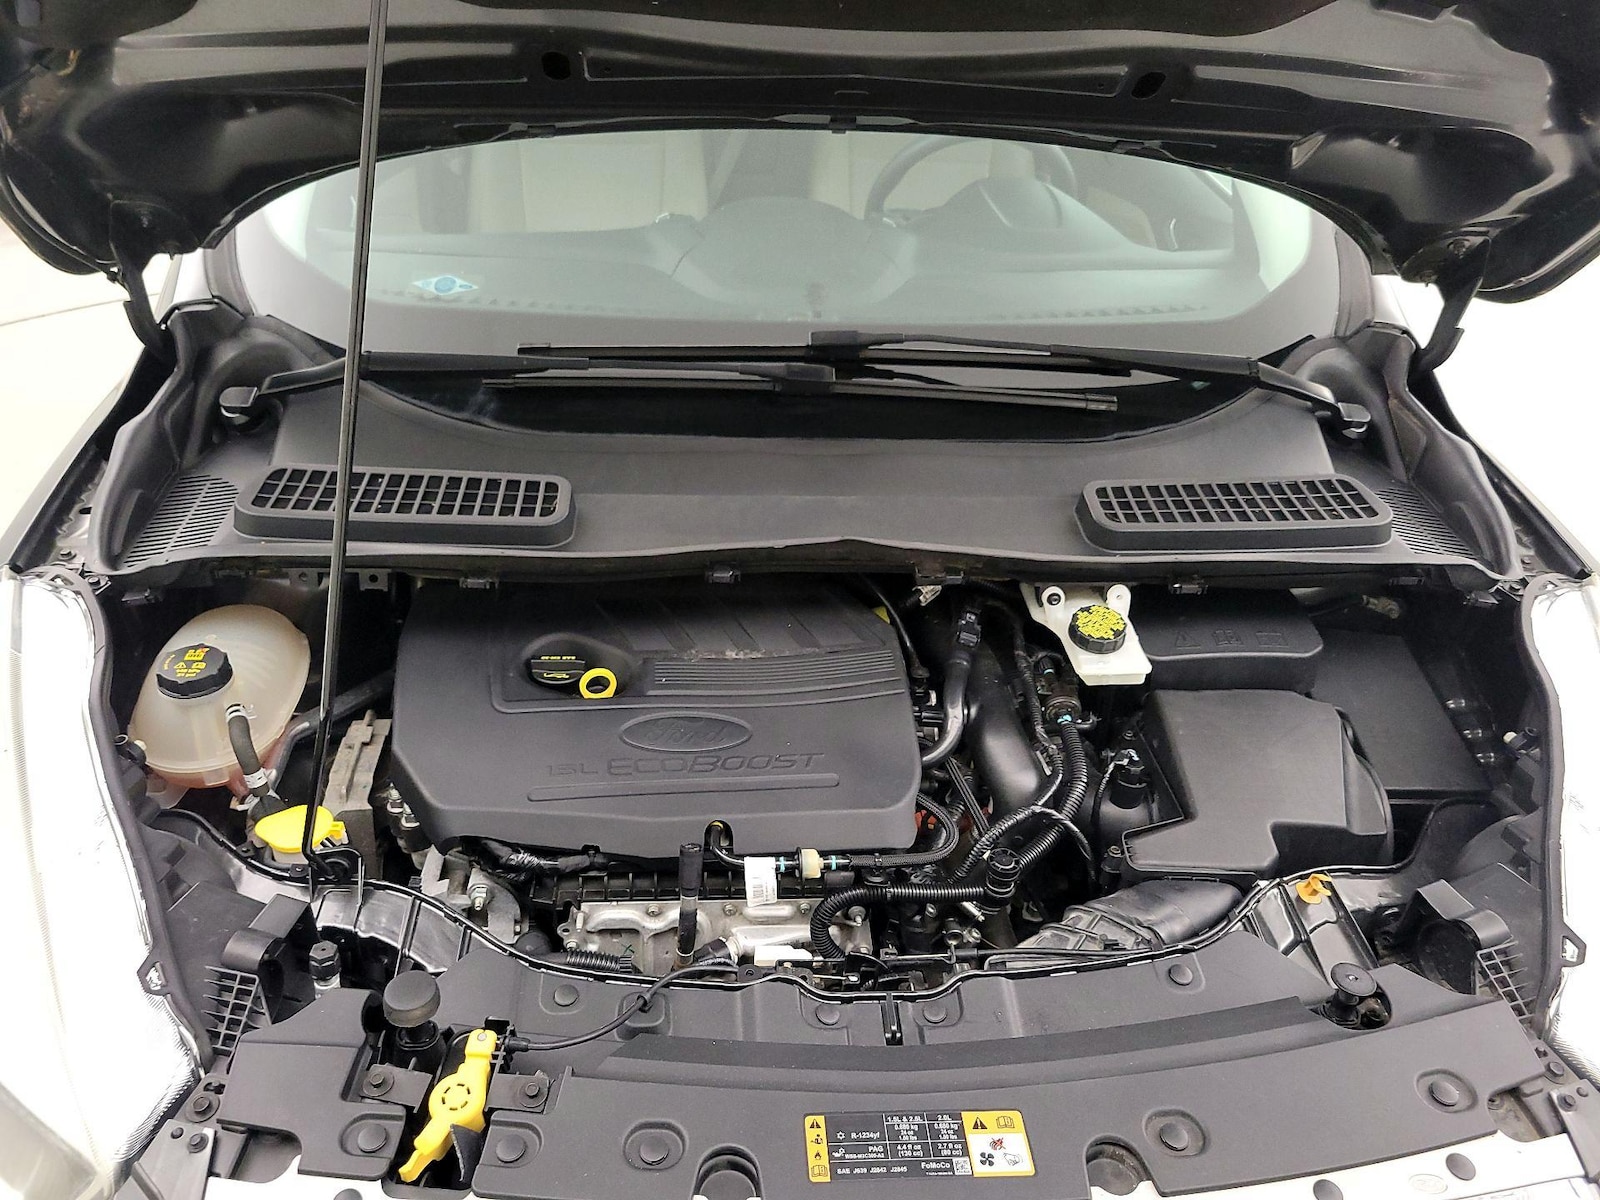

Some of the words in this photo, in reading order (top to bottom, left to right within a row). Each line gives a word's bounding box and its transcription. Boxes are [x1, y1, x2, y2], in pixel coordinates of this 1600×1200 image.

[645, 718, 727, 744] Ford
[851, 1132, 880, 1140] R-1234yf
[921, 1161, 951, 1169] FoMoCo
